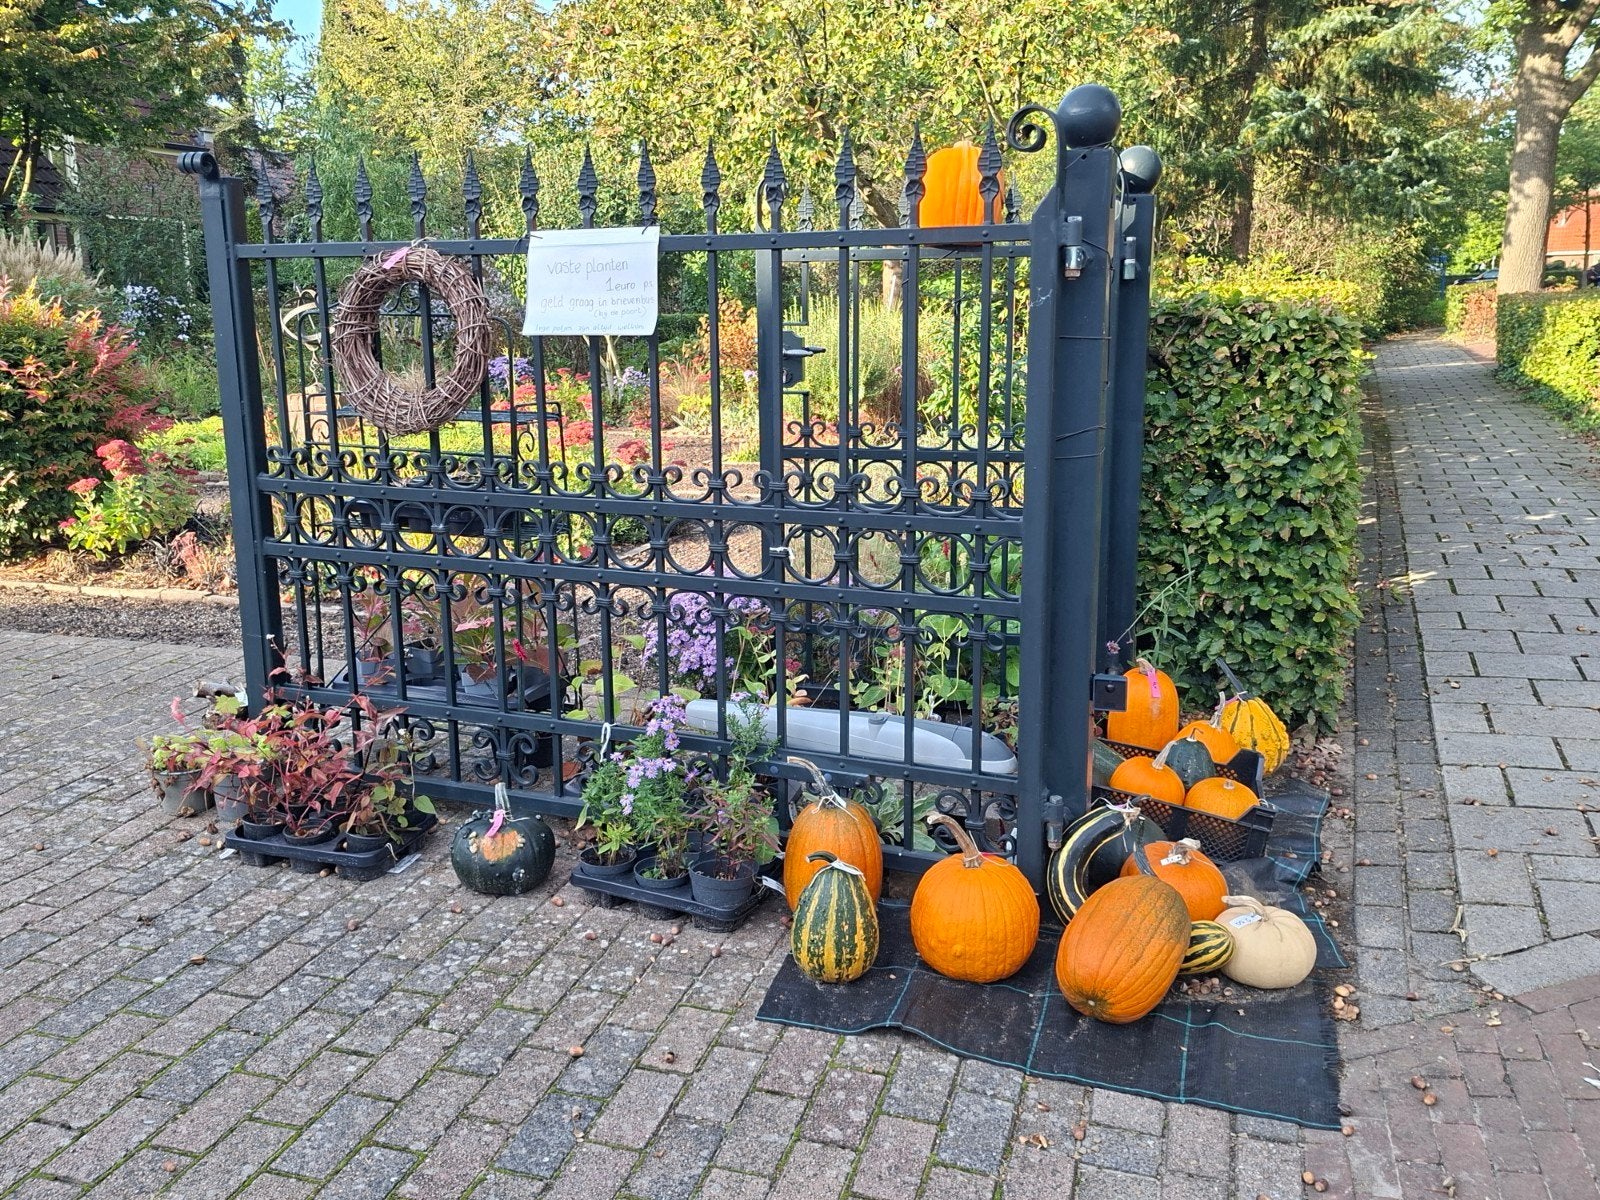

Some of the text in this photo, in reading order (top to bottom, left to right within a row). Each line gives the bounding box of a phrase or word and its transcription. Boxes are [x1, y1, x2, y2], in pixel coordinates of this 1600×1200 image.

[546, 256, 629, 280] vaste planten
[540, 294, 564, 314] geld
[569, 297, 594, 313] graag
